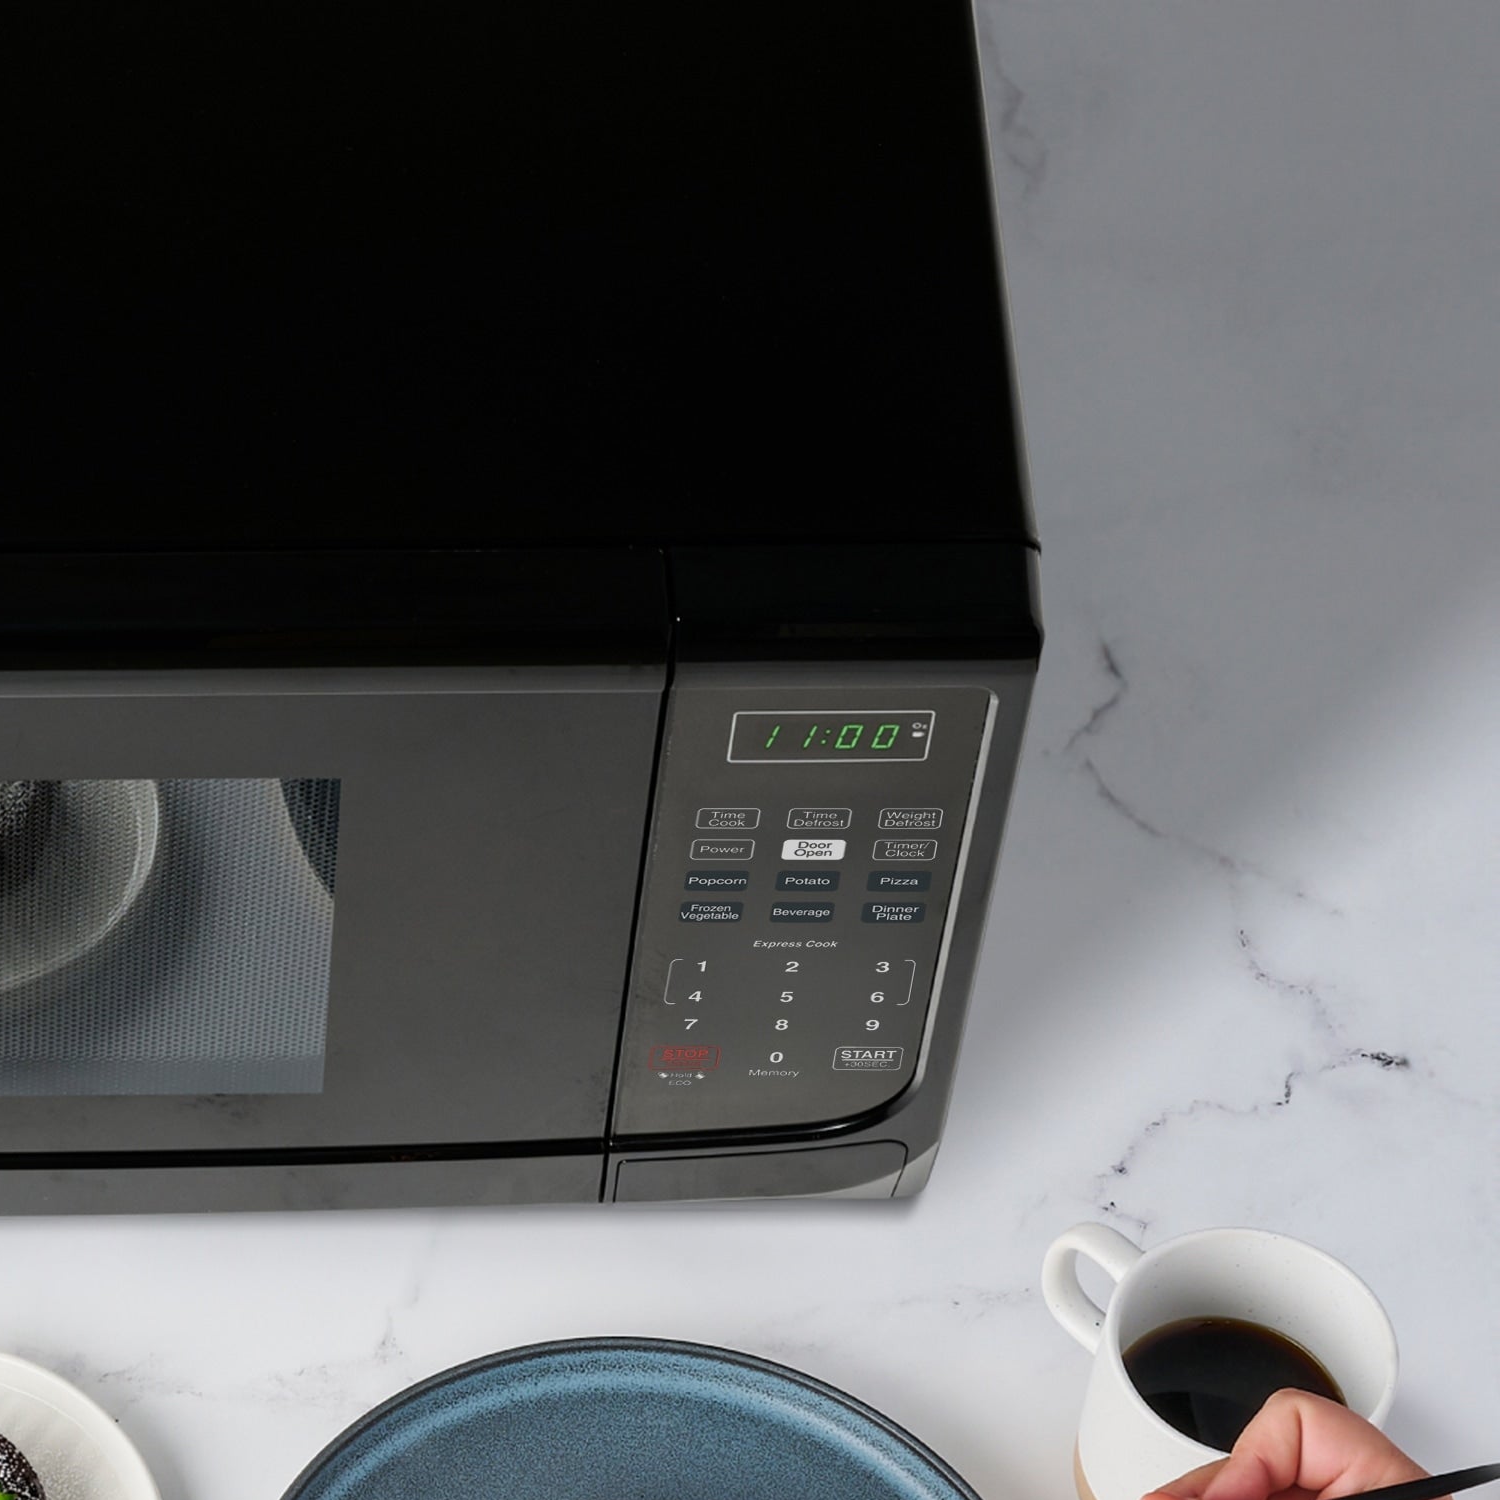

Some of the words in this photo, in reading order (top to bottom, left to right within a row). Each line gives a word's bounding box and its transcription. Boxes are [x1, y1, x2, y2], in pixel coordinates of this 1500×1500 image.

[766, 724, 900, 749] 11:00
[711, 811, 746, 819] Time
[802, 811, 837, 819] Time
[887, 811, 936, 821] Weight
[708, 819, 745, 827] Cook
[793, 819, 845, 827] Defrost
[884, 818, 936, 827] Defrost
[700, 845, 745, 854] Power
[798, 841, 832, 849] Door
[884, 841, 929, 850] Timer/
[794, 849, 832, 858] Open
[885, 849, 924, 857] Clock
[688, 877, 747, 886] Popcorn
[785, 877, 830, 885] Potato
[880, 877, 918, 885] Pizza
[773, 908, 830, 918] Beverage
[872, 905, 919, 913] Dinner
[681, 912, 739, 921] Vegetable
[876, 912, 912, 921] Plate
[753, 940, 802, 949] Express
[806, 940, 838, 948] Cook
[696, 961, 708, 972] 1
[785, 961, 799, 973] 2
[875, 962, 890, 973] 3
[688, 991, 702, 1002] 4
[780, 991, 794, 1002] 5
[870, 991, 885, 1003] 6
[684, 1019, 698, 1030] 7
[775, 1019, 789, 1030] 8
[865, 1020, 880, 1031] 9
[663, 1049, 709, 1057] STOP
[770, 1052, 783, 1063] 0
[841, 1050, 897, 1058] START
[748, 1069, 799, 1078] Memory
